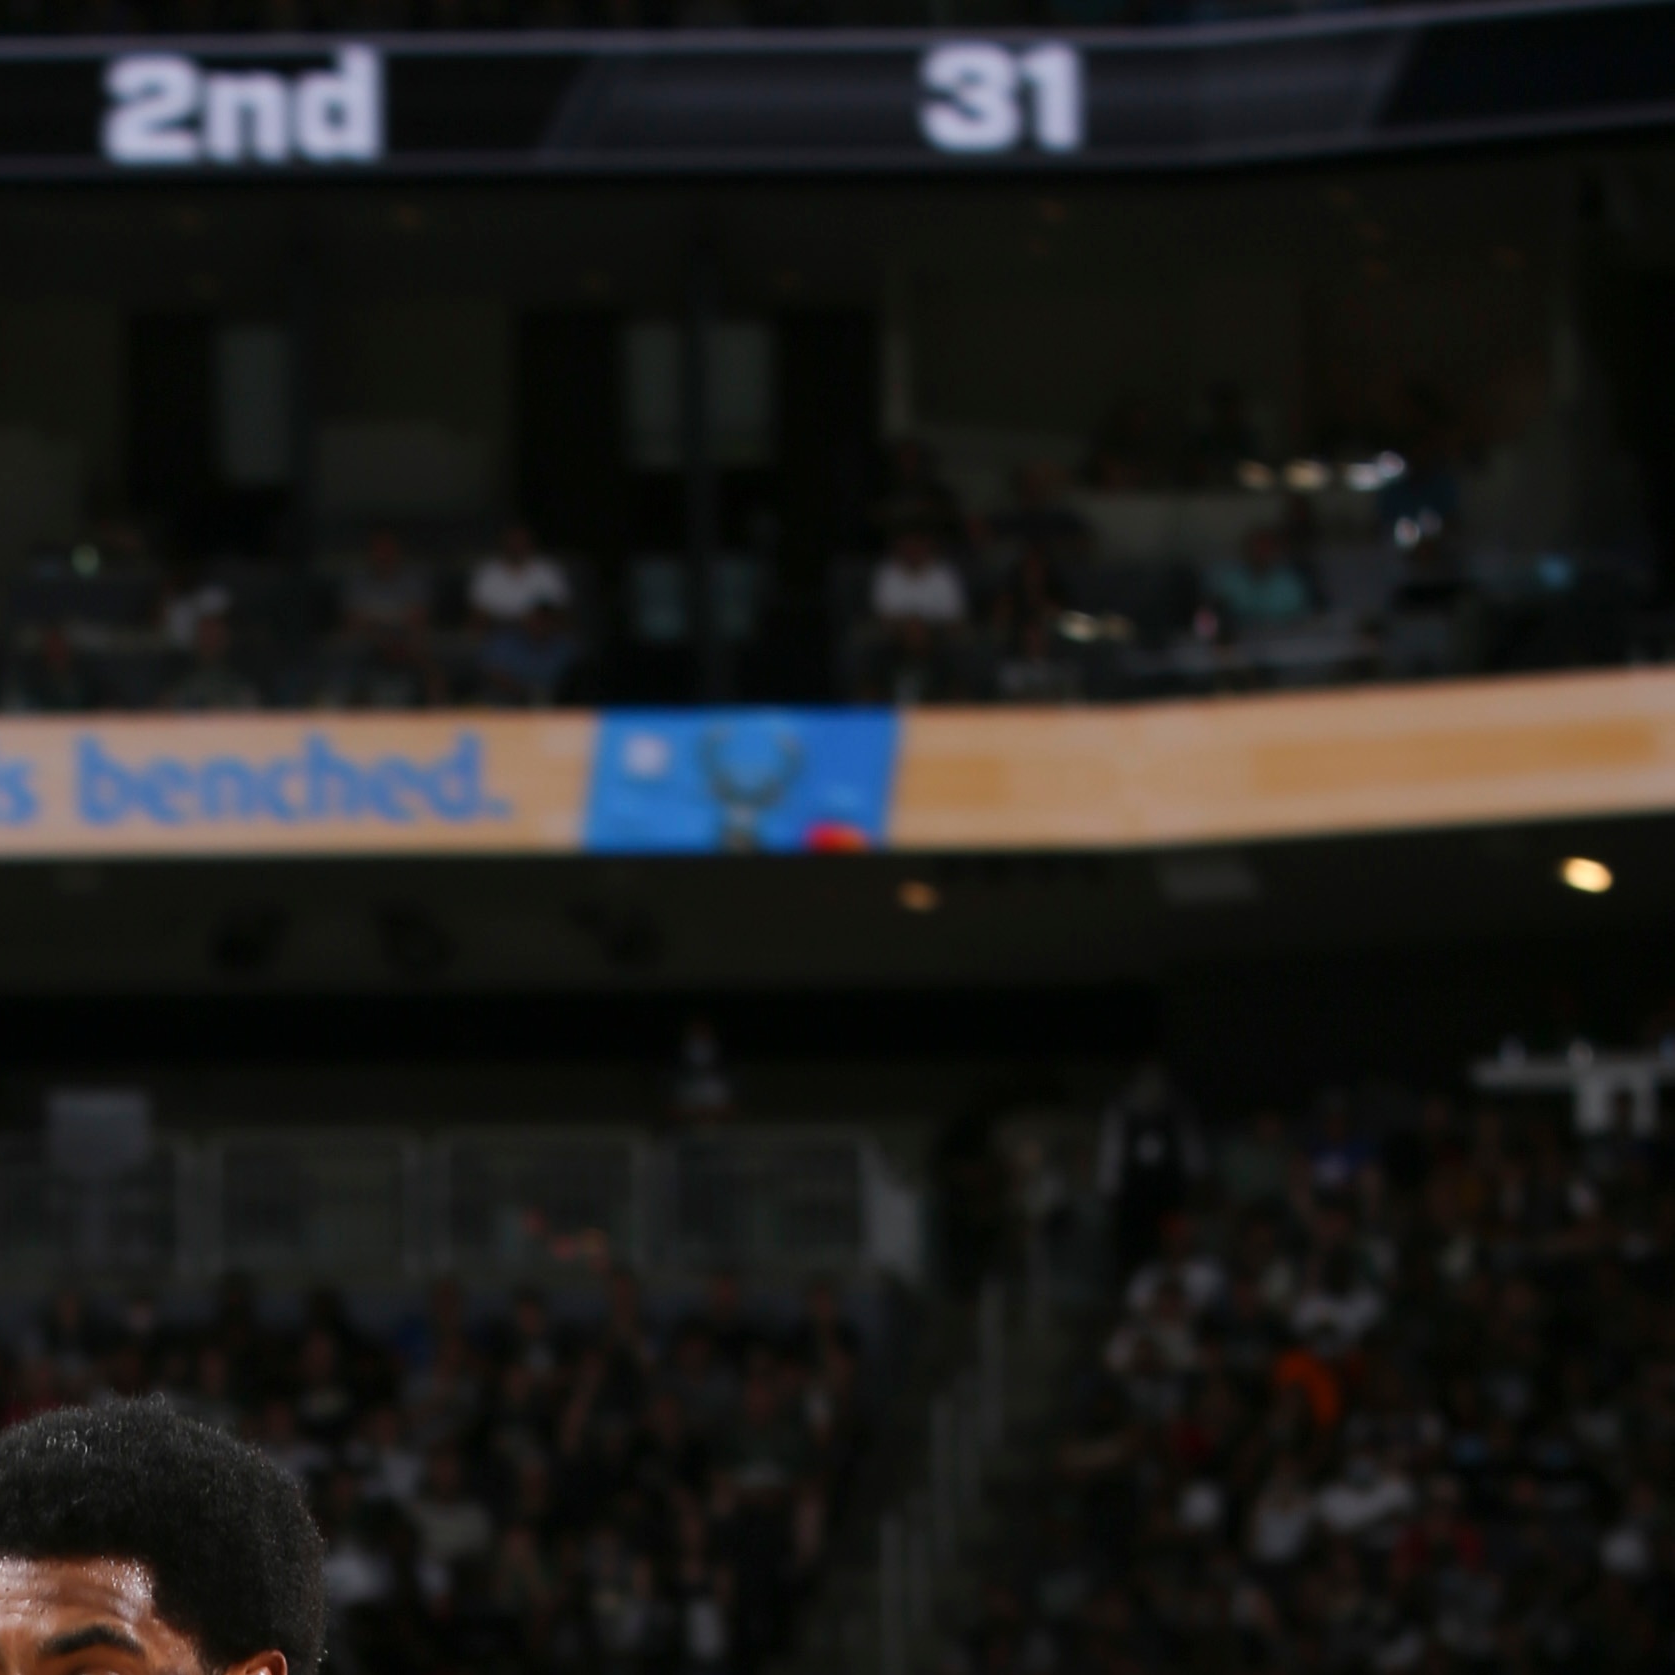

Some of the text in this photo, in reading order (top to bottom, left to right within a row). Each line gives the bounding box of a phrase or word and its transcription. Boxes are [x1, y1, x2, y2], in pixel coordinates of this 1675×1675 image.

[105, 45, 380, 162] 2nd
[922, 43, 1081, 150] 31
[73, 733, 509, 829] benched.
